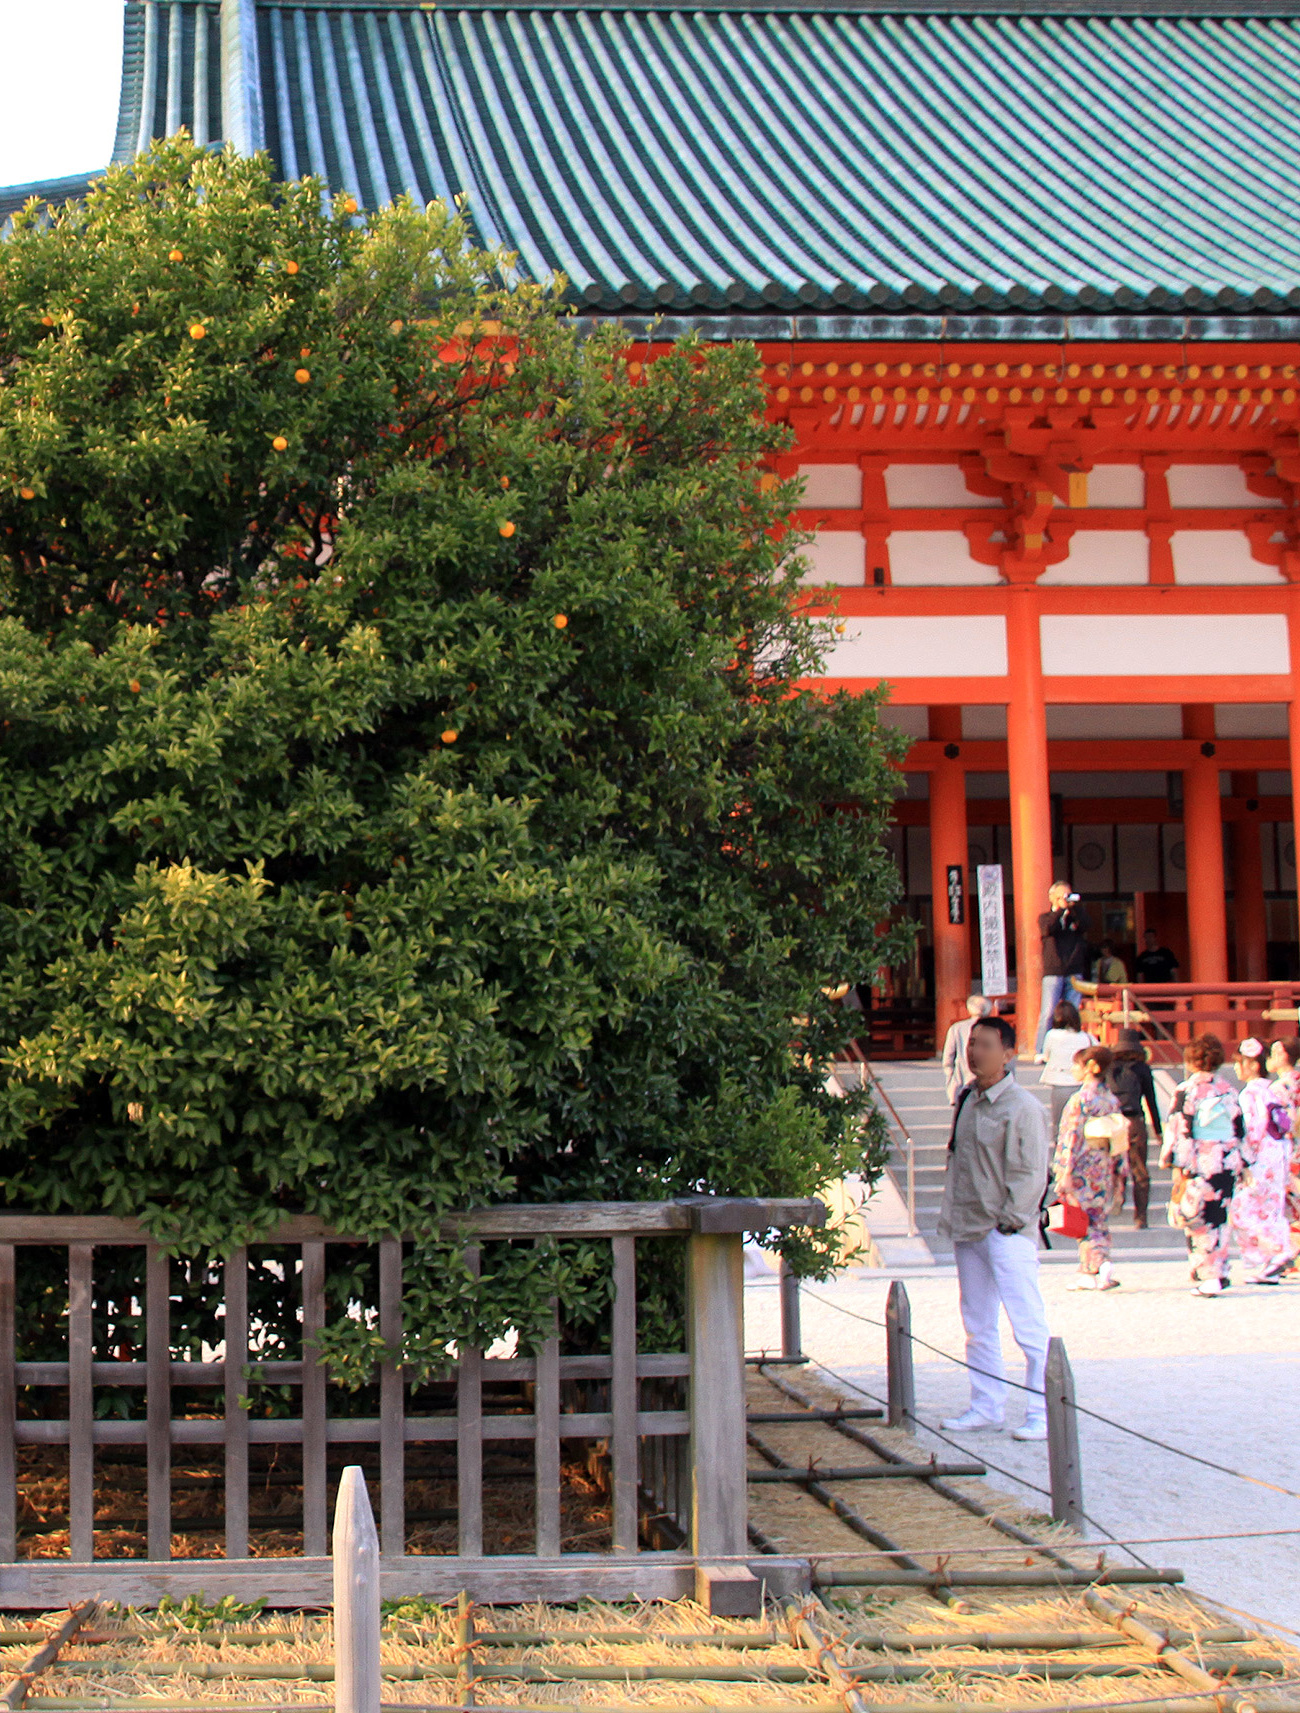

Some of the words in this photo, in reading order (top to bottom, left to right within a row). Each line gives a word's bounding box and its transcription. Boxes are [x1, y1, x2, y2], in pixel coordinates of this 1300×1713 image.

[982, 883, 1000, 979] 殿内撮影禁止
